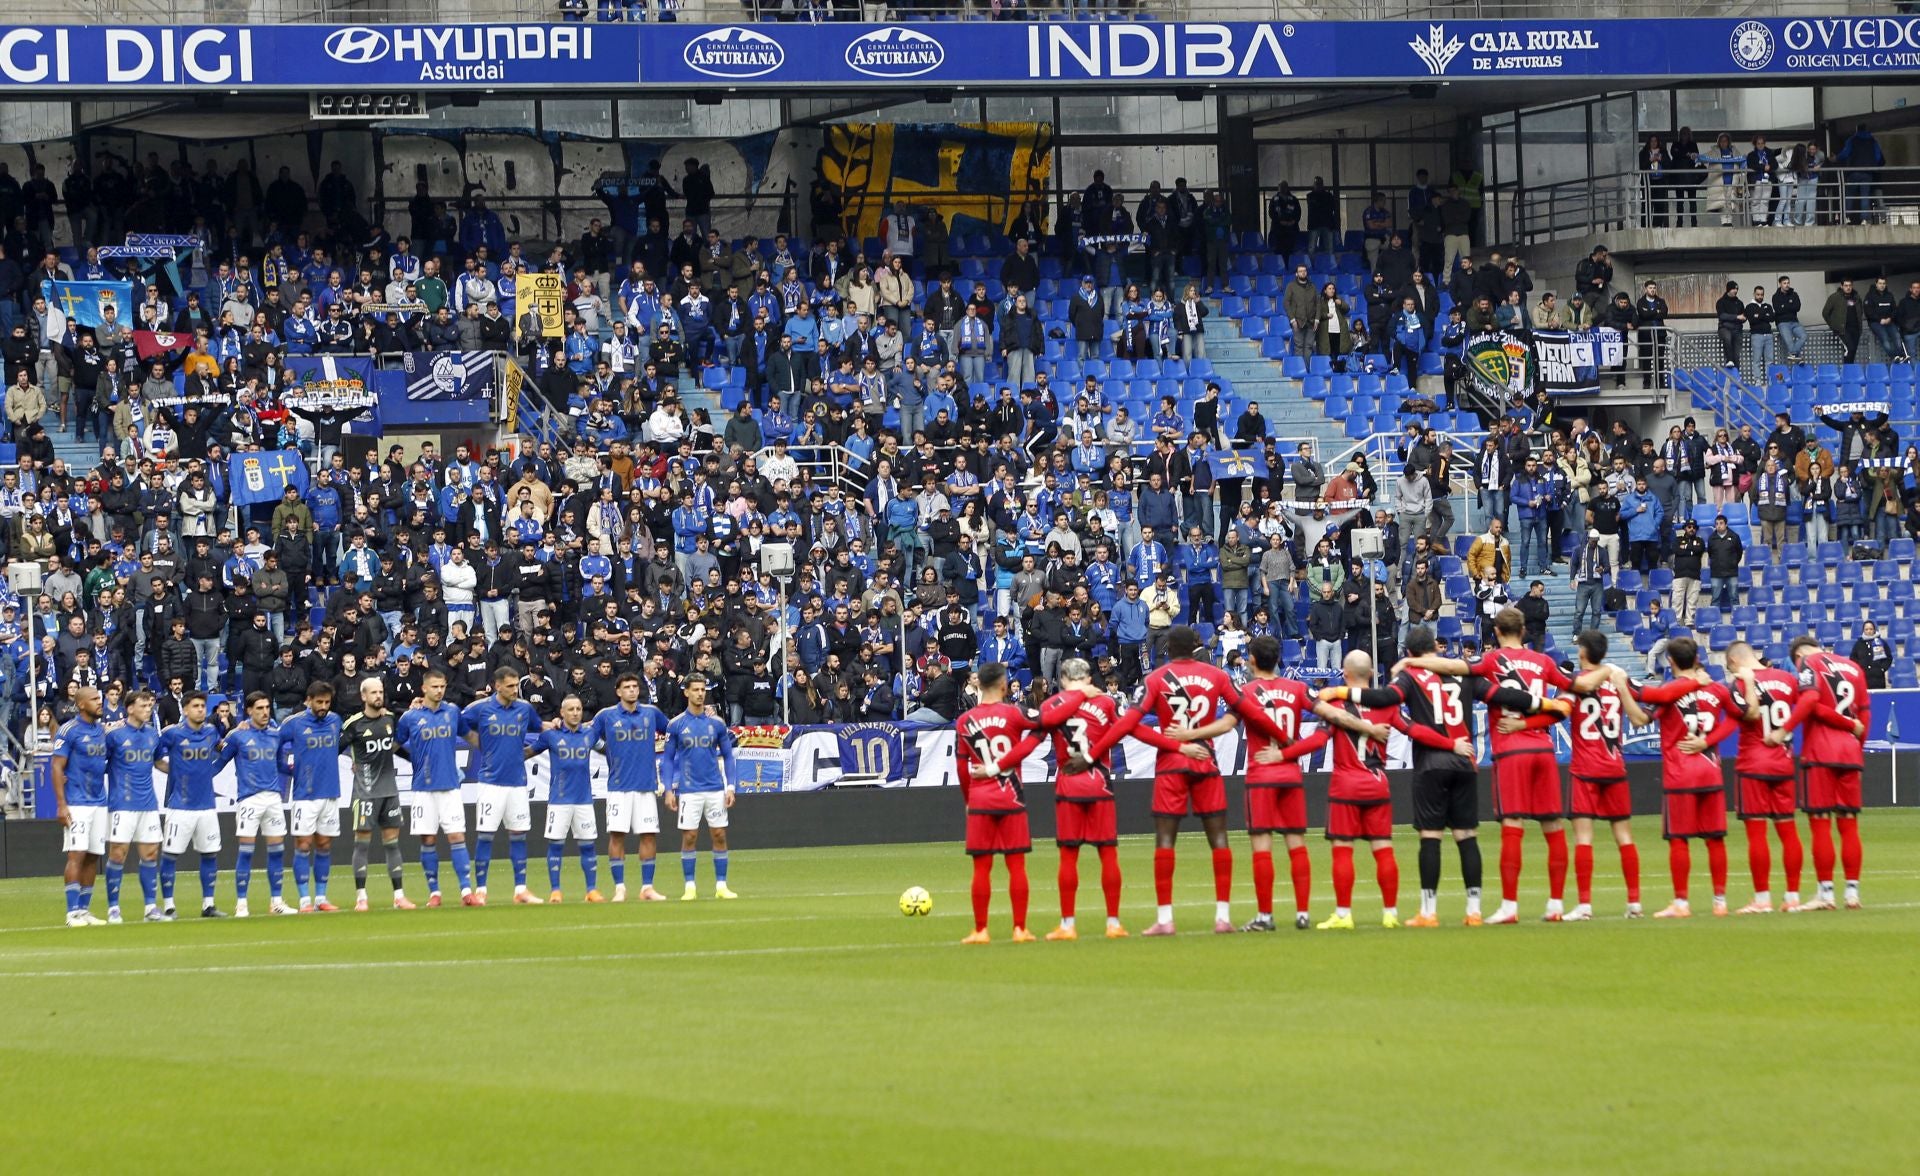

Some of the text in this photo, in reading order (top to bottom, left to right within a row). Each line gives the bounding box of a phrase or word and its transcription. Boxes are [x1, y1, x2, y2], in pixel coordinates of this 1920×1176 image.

[1735, 22, 1769, 37] OVIEDO
[393, 26, 593, 60] HYUNDAI
[1469, 30, 1600, 53] CAJA RURAL
[105, 28, 254, 83] DIGI
[692, 44, 778, 65] ASTURIANA
[852, 45, 938, 65] ASTURIANA
[1786, 54, 1840, 68] ORIGEN
[1843, 53, 1870, 68] DEL
[1472, 55, 1563, 70] DE ASTURIAS
[419, 60, 505, 81] Asturdai
[1535, 340, 1571, 363] VETU
[1823, 401, 1883, 415] ROCKERS
[1427, 682, 1464, 726] 13
[1834, 680, 1855, 719] 2
[1167, 694, 1210, 730] 32
[1579, 695, 1621, 741] 23
[1760, 700, 1793, 742] 19
[421, 725, 451, 741] DIGI
[488, 723, 521, 737] DIGI
[615, 728, 648, 742] DIGI
[839, 721, 900, 741] VILLAVERDE
[1065, 717, 1090, 758] 3
[306, 735, 337, 749] DIGI
[682, 735, 713, 748] DIGI
[86, 743, 106, 757] DIG
[125, 749, 151, 763] DIG
[558, 746, 590, 760] DIGI
[974, 734, 1012, 776] 18
[851, 736, 891, 780] 10
[240, 806, 256, 820] 22
[295, 807, 302, 821] 4
[360, 801, 373, 816] 13
[480, 803, 492, 816] 12
[71, 820, 86, 834] 23
[169, 823, 178, 837] 11
